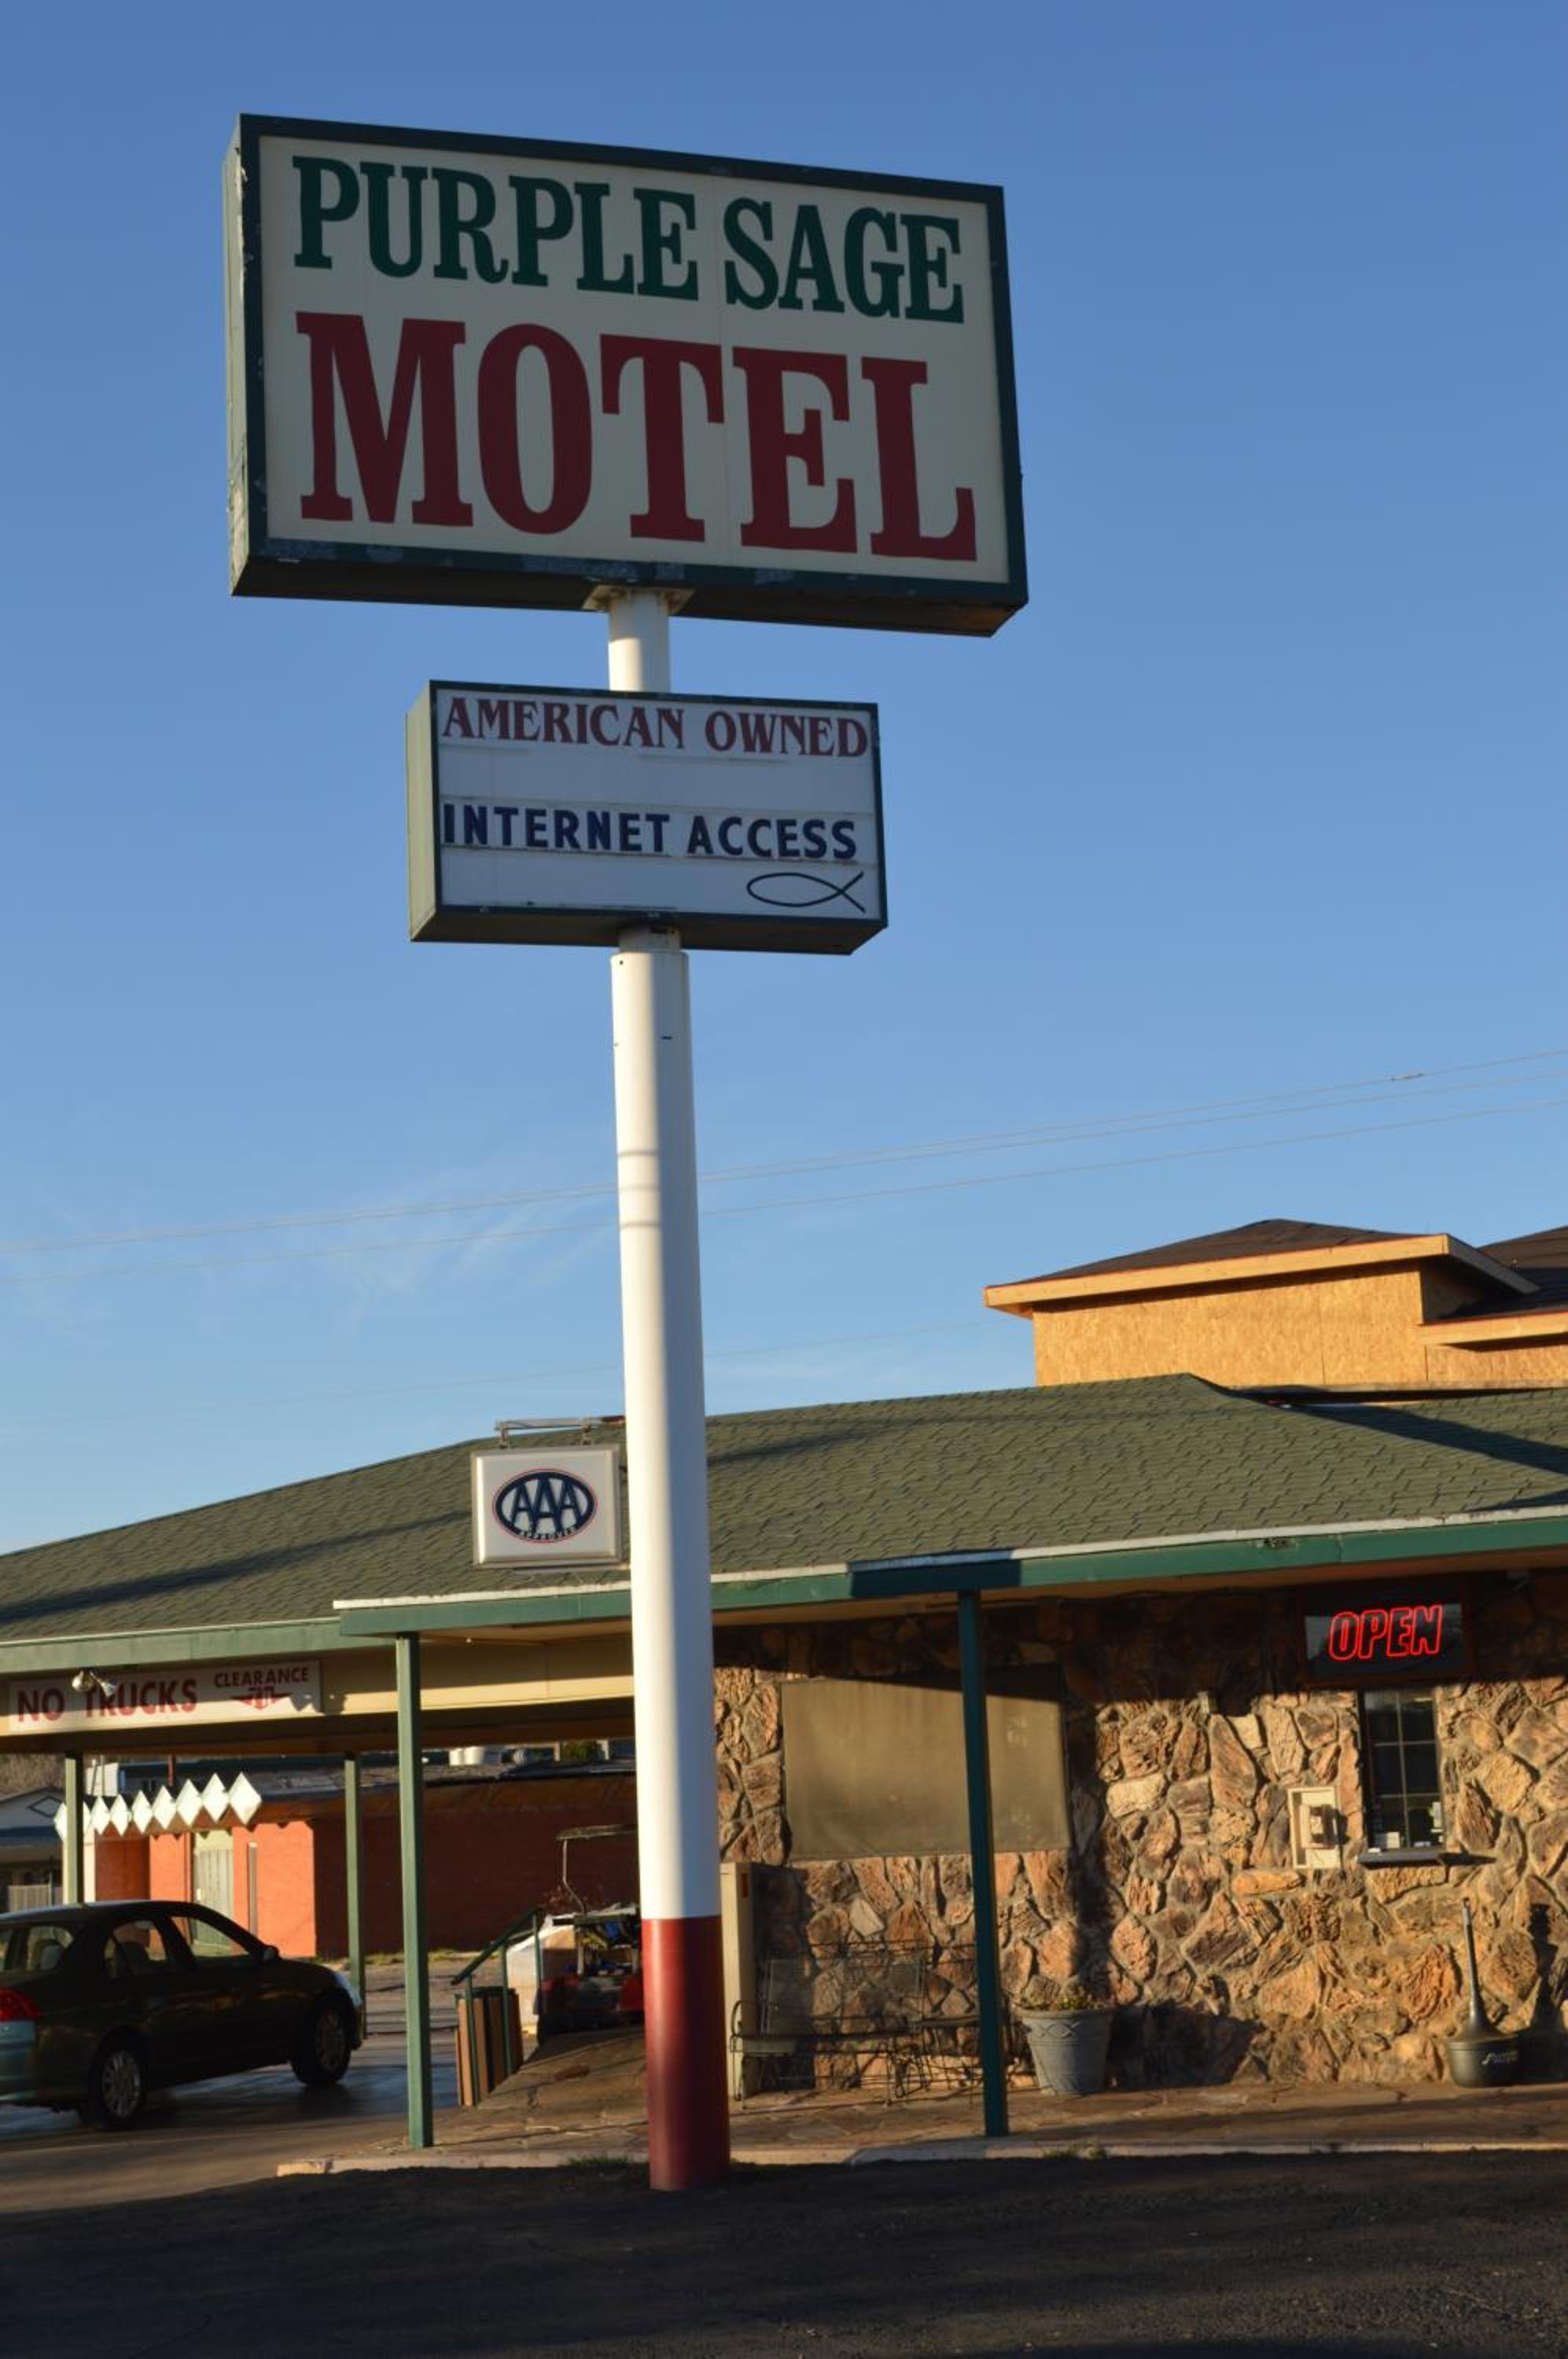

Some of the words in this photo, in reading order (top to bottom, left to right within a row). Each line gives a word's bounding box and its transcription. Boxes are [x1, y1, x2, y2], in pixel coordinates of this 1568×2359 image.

[293, 156, 699, 301] PURPLE
[723, 197, 964, 324] SAGE
[295, 311, 977, 562] MOTEL
[442, 697, 685, 749] AMERICAN
[705, 711, 867, 758] OWNED
[444, 804, 670, 852] INTERNET
[687, 815, 857, 860] ACCESS
[510, 1477, 585, 1536] AAA
[1329, 1604, 1444, 1661] OPEN
[17, 1688, 65, 1722] NO
[214, 1666, 309, 1688] CLEARANCE
